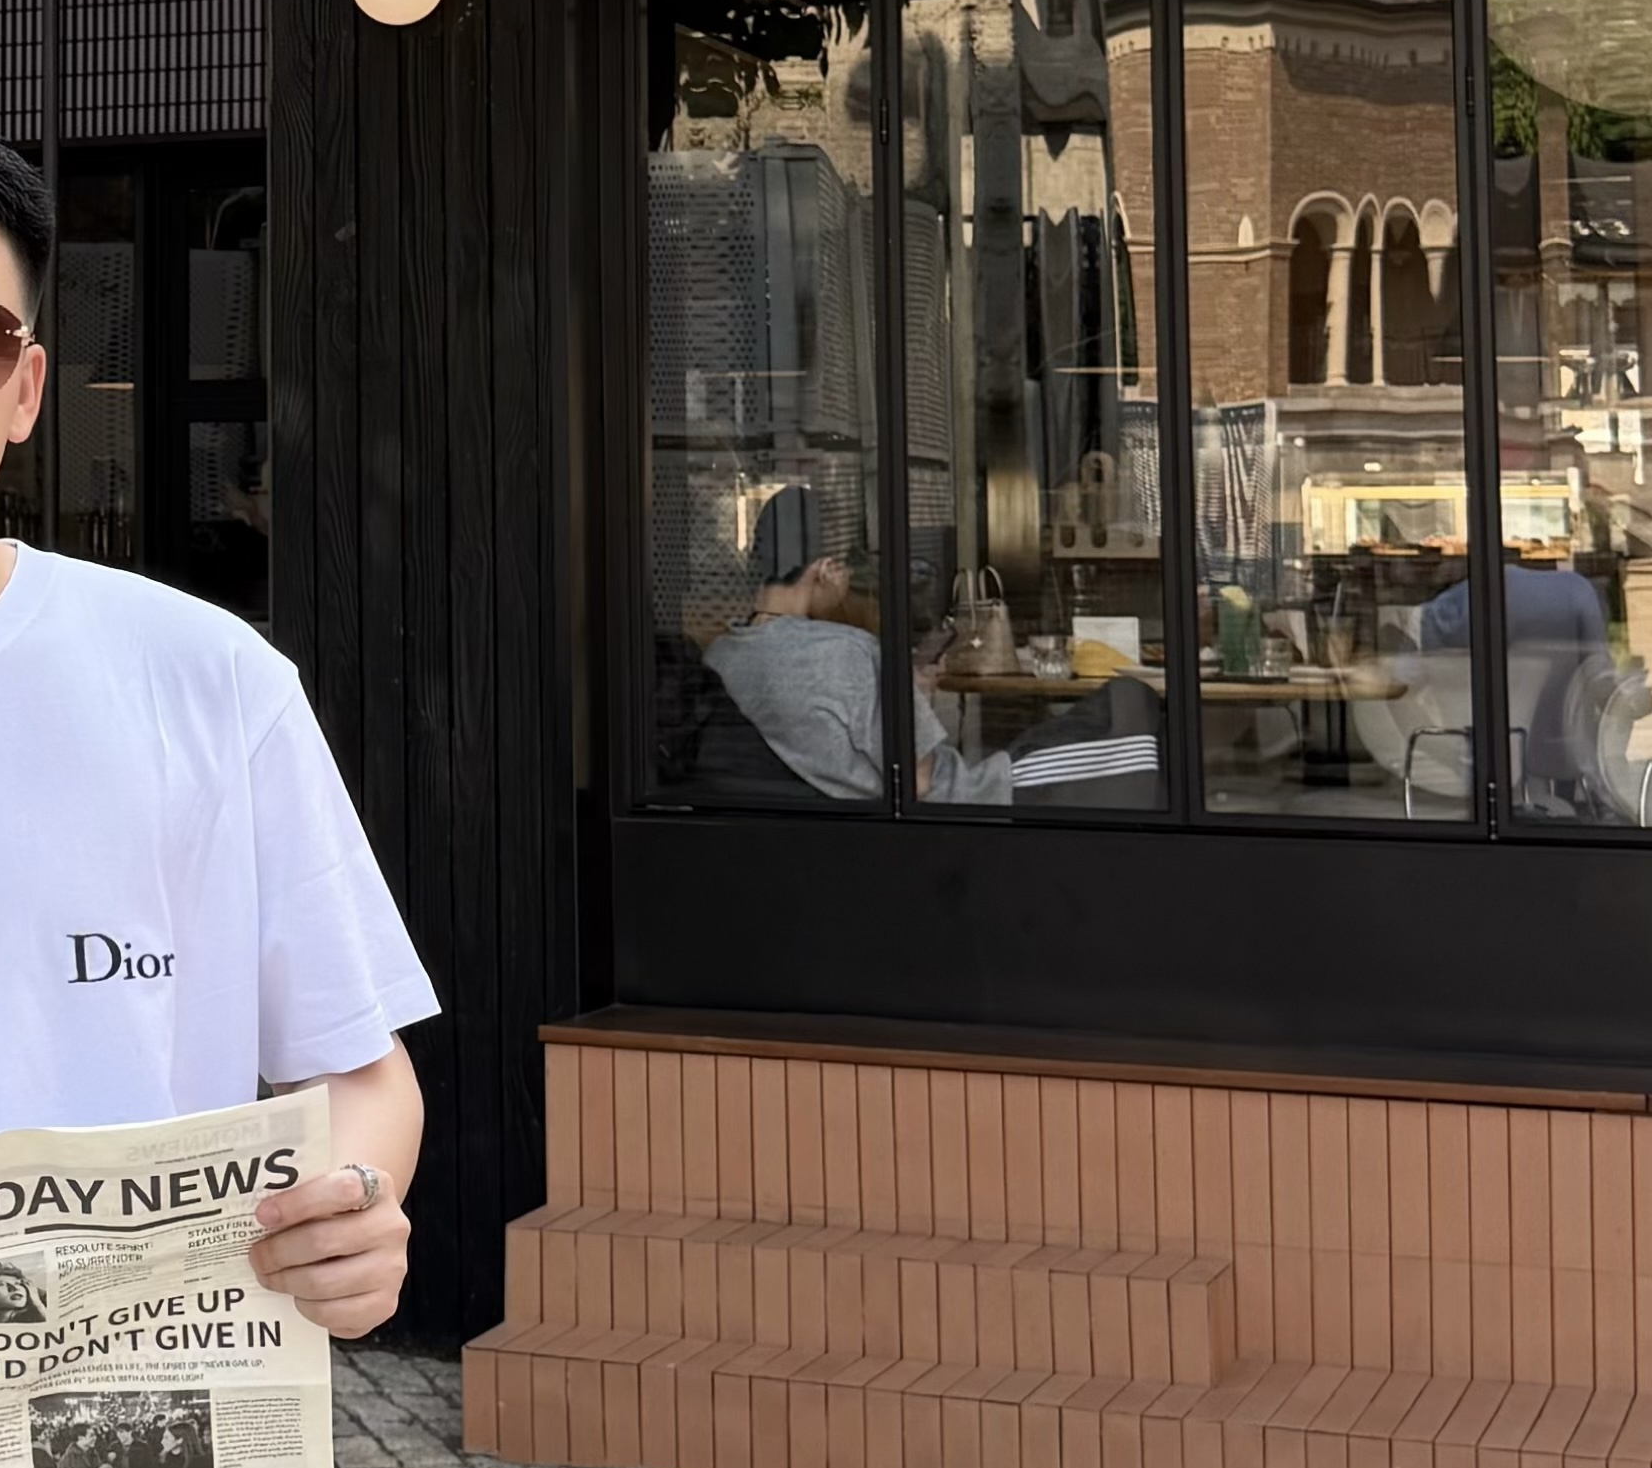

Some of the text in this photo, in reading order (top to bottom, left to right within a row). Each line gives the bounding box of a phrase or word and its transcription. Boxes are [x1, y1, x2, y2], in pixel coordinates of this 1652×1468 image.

[66, 933, 175, 983] Dior
[121, 1148, 299, 1216] NEWS
[55, 1242, 114, 1258] RESOLUTE
[188, 1225, 225, 1239] STAND
[188, 1234, 228, 1249] REFUSE
[232, 1230, 247, 1239] TO
[108, 1295, 186, 1327] GIVE
[197, 1287, 246, 1314] UP
[38, 1328, 146, 1374] DON'T
[155, 1320, 236, 1352] GIVE
[247, 1319, 282, 1348] IN
